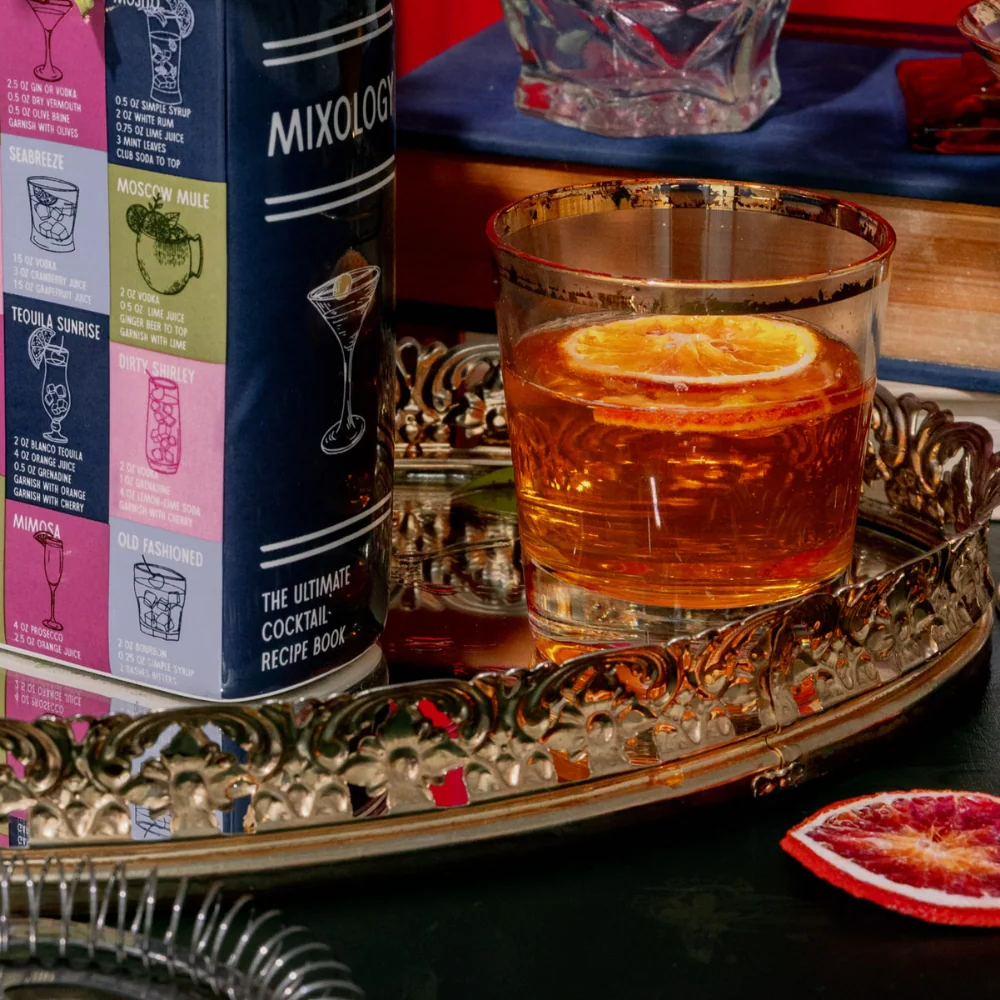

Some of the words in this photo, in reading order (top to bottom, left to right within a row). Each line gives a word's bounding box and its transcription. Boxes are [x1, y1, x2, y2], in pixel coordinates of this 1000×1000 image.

[7, 79, 18, 89] 2.5
[20, 81, 29, 91] OZ
[30, 82, 43, 93] GIN
[44, 84, 54, 94] OR
[55, 86, 77, 99] VODKA
[7, 92, 19, 102] 0.5
[21, 94, 30, 104] OZ
[32, 96, 44, 106] DRY
[46, 98, 82, 113] VERMOUTH
[8, 105, 20, 115] 0.5
[21, 106, 31, 117] OZ
[32, 109, 50, 120] OLIVE
[51, 112, 70, 124] BRINE
[115, 95, 128, 107] 0.5
[130, 98, 139, 109] OZ
[141, 100, 166, 114] SIMPLE
[168, 105, 192, 119] SYRUP
[268, 70, 394, 157] MIXOLOGY
[8, 117, 36, 130] GARNISH
[37, 122, 55, 133] WITH
[56, 126, 79, 139] OLIVES
[116, 109, 121, 119] 2
[122, 109, 132, 121] OZ
[134, 112, 155, 125] WHITE
[157, 116, 175, 128] RUM
[116, 121, 133, 134] 0.75
[134, 125, 144, 137] OZ
[145, 127, 163, 140] LIME
[164, 131, 185, 144] JUICE
[116, 134, 121, 145] 3
[123, 136, 141, 149] MINT
[143, 140, 167, 154] LEAVES
[9, 145, 65, 170] SEABREEZE
[116, 147, 133, 161] CLUB
[135, 151, 154, 165] SODA
[156, 155, 165, 167] TO
[167, 157, 181, 169] TOP
[117, 177, 173, 203] MOSCOW
[176, 188, 210, 210] MULE
[120, 287, 125, 297] 2
[126, 288, 136, 300] OZ
[137, 291, 160, 305] VODKA
[11, 305, 54, 330] TEQUILA
[57, 316, 101, 341] SUNRISE
[119, 313, 144, 328] GINGER
[146, 319, 162, 332] BEER
[163, 323, 173, 334] TO
[175, 325, 188, 337] TOP
[134, 303, 144, 314] OZ
[147, 306, 164, 320] LIME
[166, 310, 185, 324] JUICE
[119, 326, 149, 341] GARNISH
[150, 334, 168, 346] WITH
[169, 338, 187, 351] LIME
[119, 353, 149, 374] DIRTY
[152, 361, 195, 385] SHIRLEY
[14, 436, 19, 445] 2
[20, 437, 29, 448] OZ
[31, 440, 56, 454] BLANCO
[57, 446, 83, 461] TEQUILA
[13, 449, 19, 459] 4
[20, 450, 30, 461] OZ
[31, 453, 56, 467] ORANGE
[58, 460, 76, 473] JUICE
[13, 461, 26, 473] 0.5
[27, 465, 36, 475] OZ
[37, 467, 72, 484] GRENADINE
[13, 474, 41, 489] GARNISH
[42, 480, 59, 494] WITH
[60, 486, 86, 501] ORANGE
[13, 487, 41, 502] GARNISH
[42, 494, 59, 507] WITH
[60, 498, 85, 513] CHERRY
[13, 513, 61, 540] MIMOSA
[118, 531, 139, 551] OLD
[143, 538, 203, 568] FASHIONED
[261, 587, 288, 612] THE
[294, 564, 350, 604] ULTIMATE
[13, 621, 18, 630] 4
[20, 622, 29, 633] OZ
[31, 625, 64, 643] PROSECCO
[261, 604, 328, 642] COCKTAIL
[26, 636, 35, 646] OZ
[36, 639, 62, 654] ORANGE
[64, 647, 82, 660] JUICE
[261, 640, 308, 672] RECIPE
[313, 624, 346, 656] BOOK
